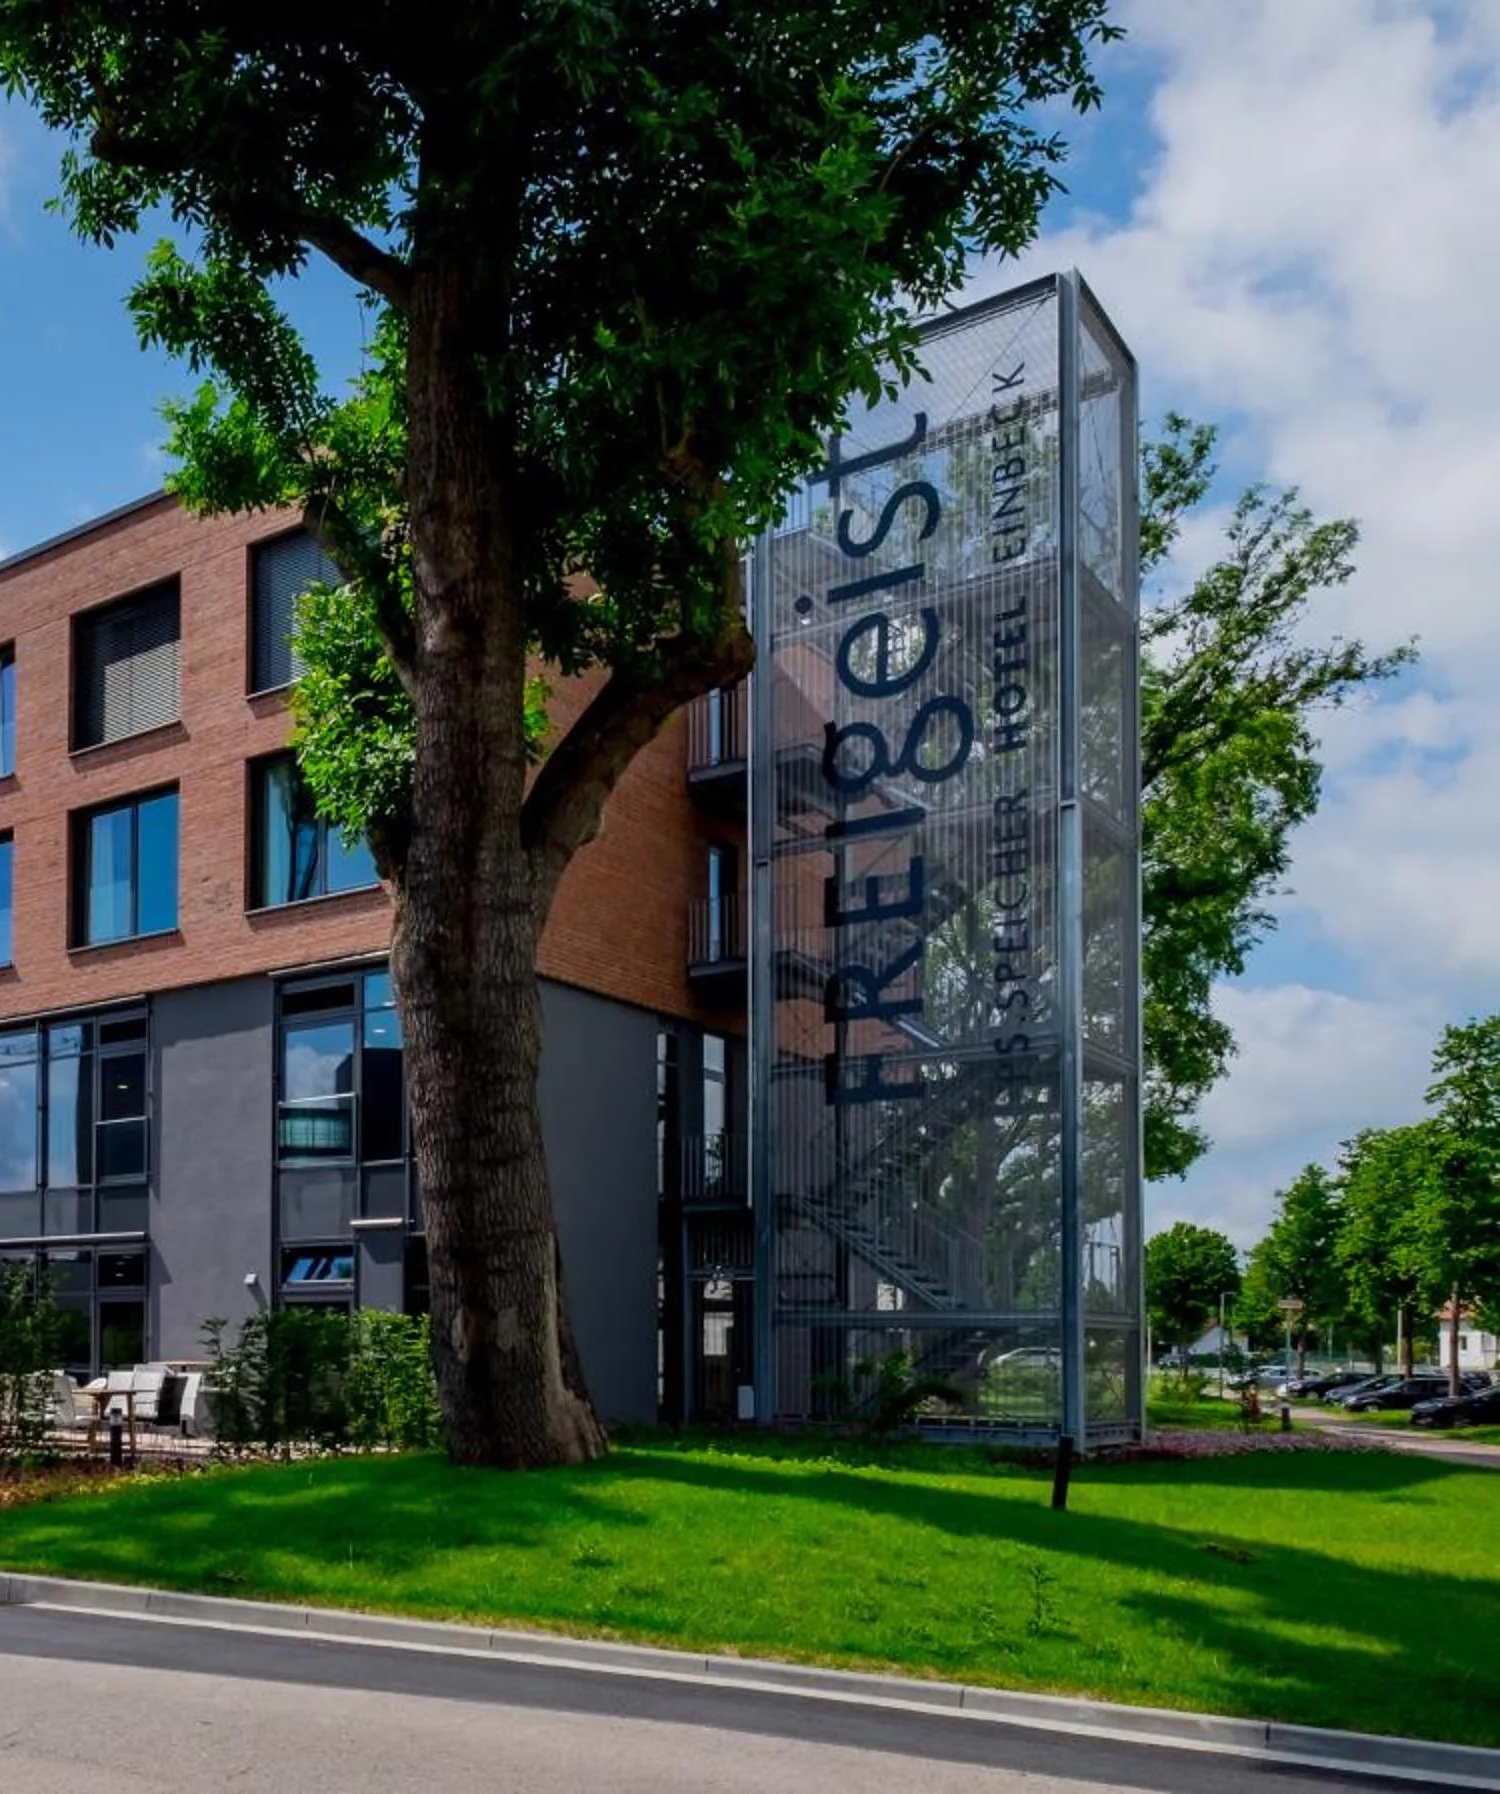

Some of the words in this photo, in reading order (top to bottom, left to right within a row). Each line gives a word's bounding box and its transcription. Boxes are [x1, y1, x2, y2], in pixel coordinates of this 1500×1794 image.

[992, 361, 1026, 563] EINBECK
[795, 412, 974, 1104] FREIgeist
[993, 594, 1028, 754] HOTEL
